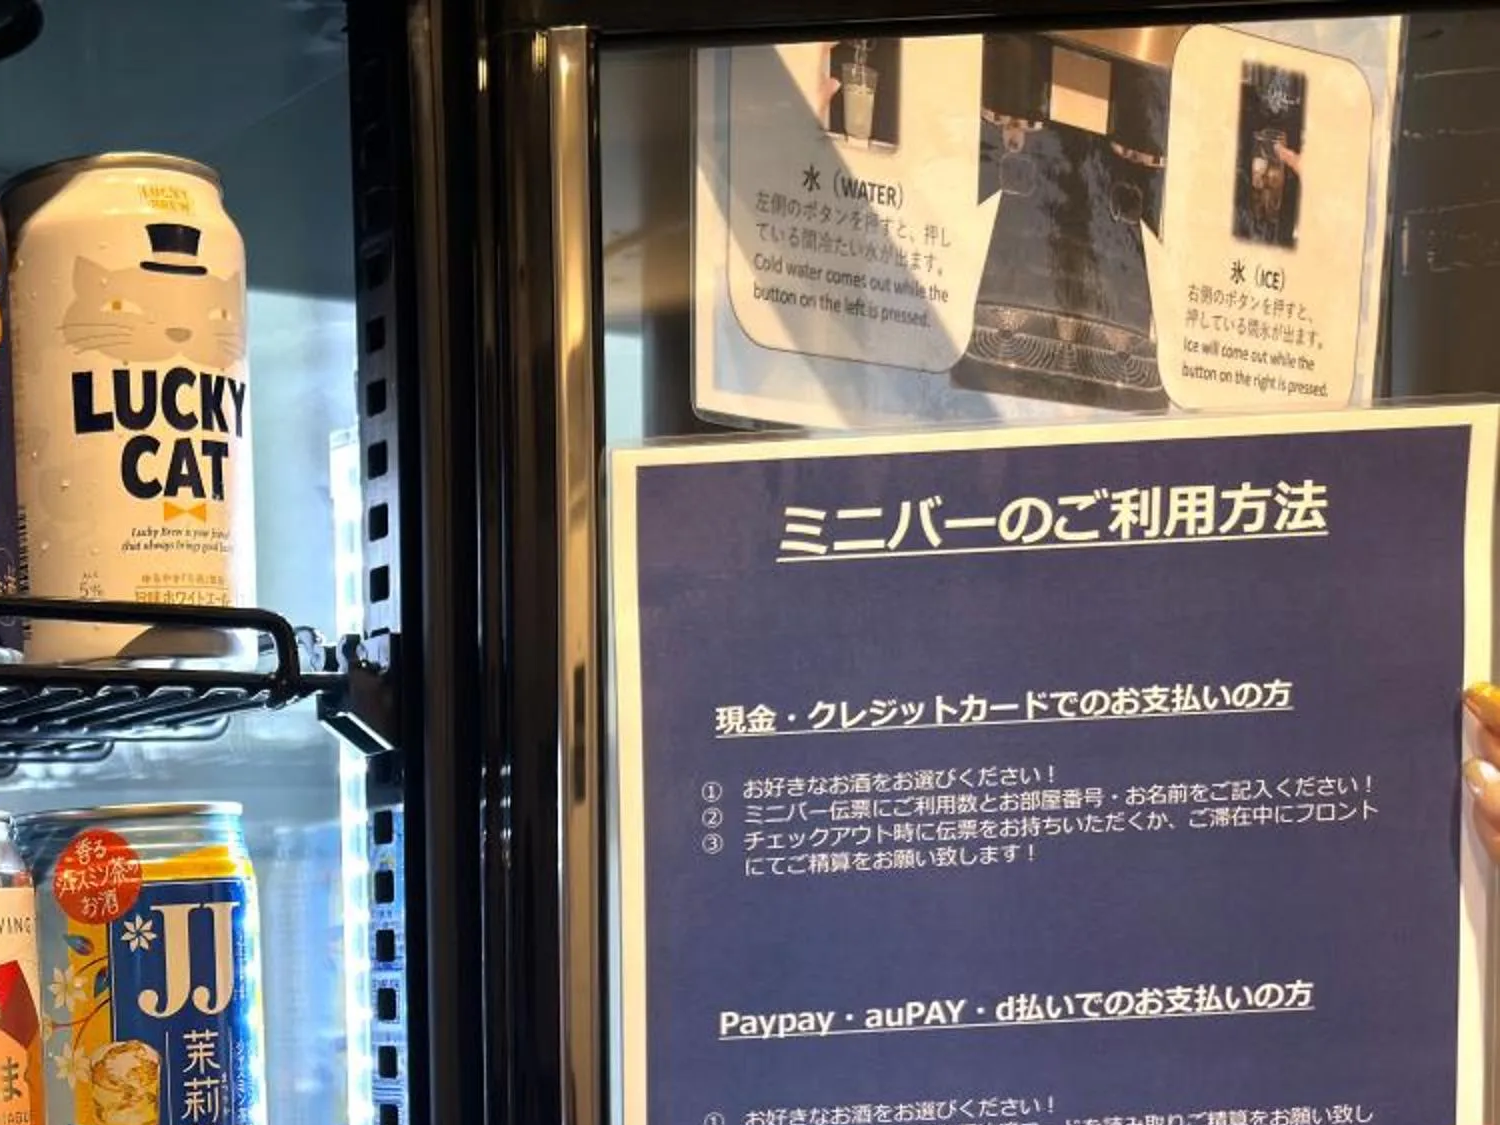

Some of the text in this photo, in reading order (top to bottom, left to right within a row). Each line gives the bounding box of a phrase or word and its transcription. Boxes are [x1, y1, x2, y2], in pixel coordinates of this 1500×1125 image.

[803, 165, 821, 193] 水
[754, 253, 949, 303] Cold water comes out while the
[1231, 260, 1246, 284] 氷
[753, 284, 932, 330] button on the left pressed.
[1183, 337, 1296, 368] Ice come while
[1181, 362, 1277, 392] button the right
[72, 366, 246, 438] LUCKY
[121, 434, 229, 501] CAT
[779, 479, 1329, 557] ミニバーのご利用方法
[715, 678, 1293, 735] 現金・クレジットカードでのお支払いの方
[742, 765, 1054, 800] お好きなお酒をお選びください！
[74, 837, 108, 866] 香る
[744, 844, 1035, 877] にてご精算をお願い致します！
[81, 888, 119, 917] お酒
[138, 903, 240, 1018] JJ
[719, 979, 1315, 1038] Paypay・auPAY・d払いでのお支払いの方
